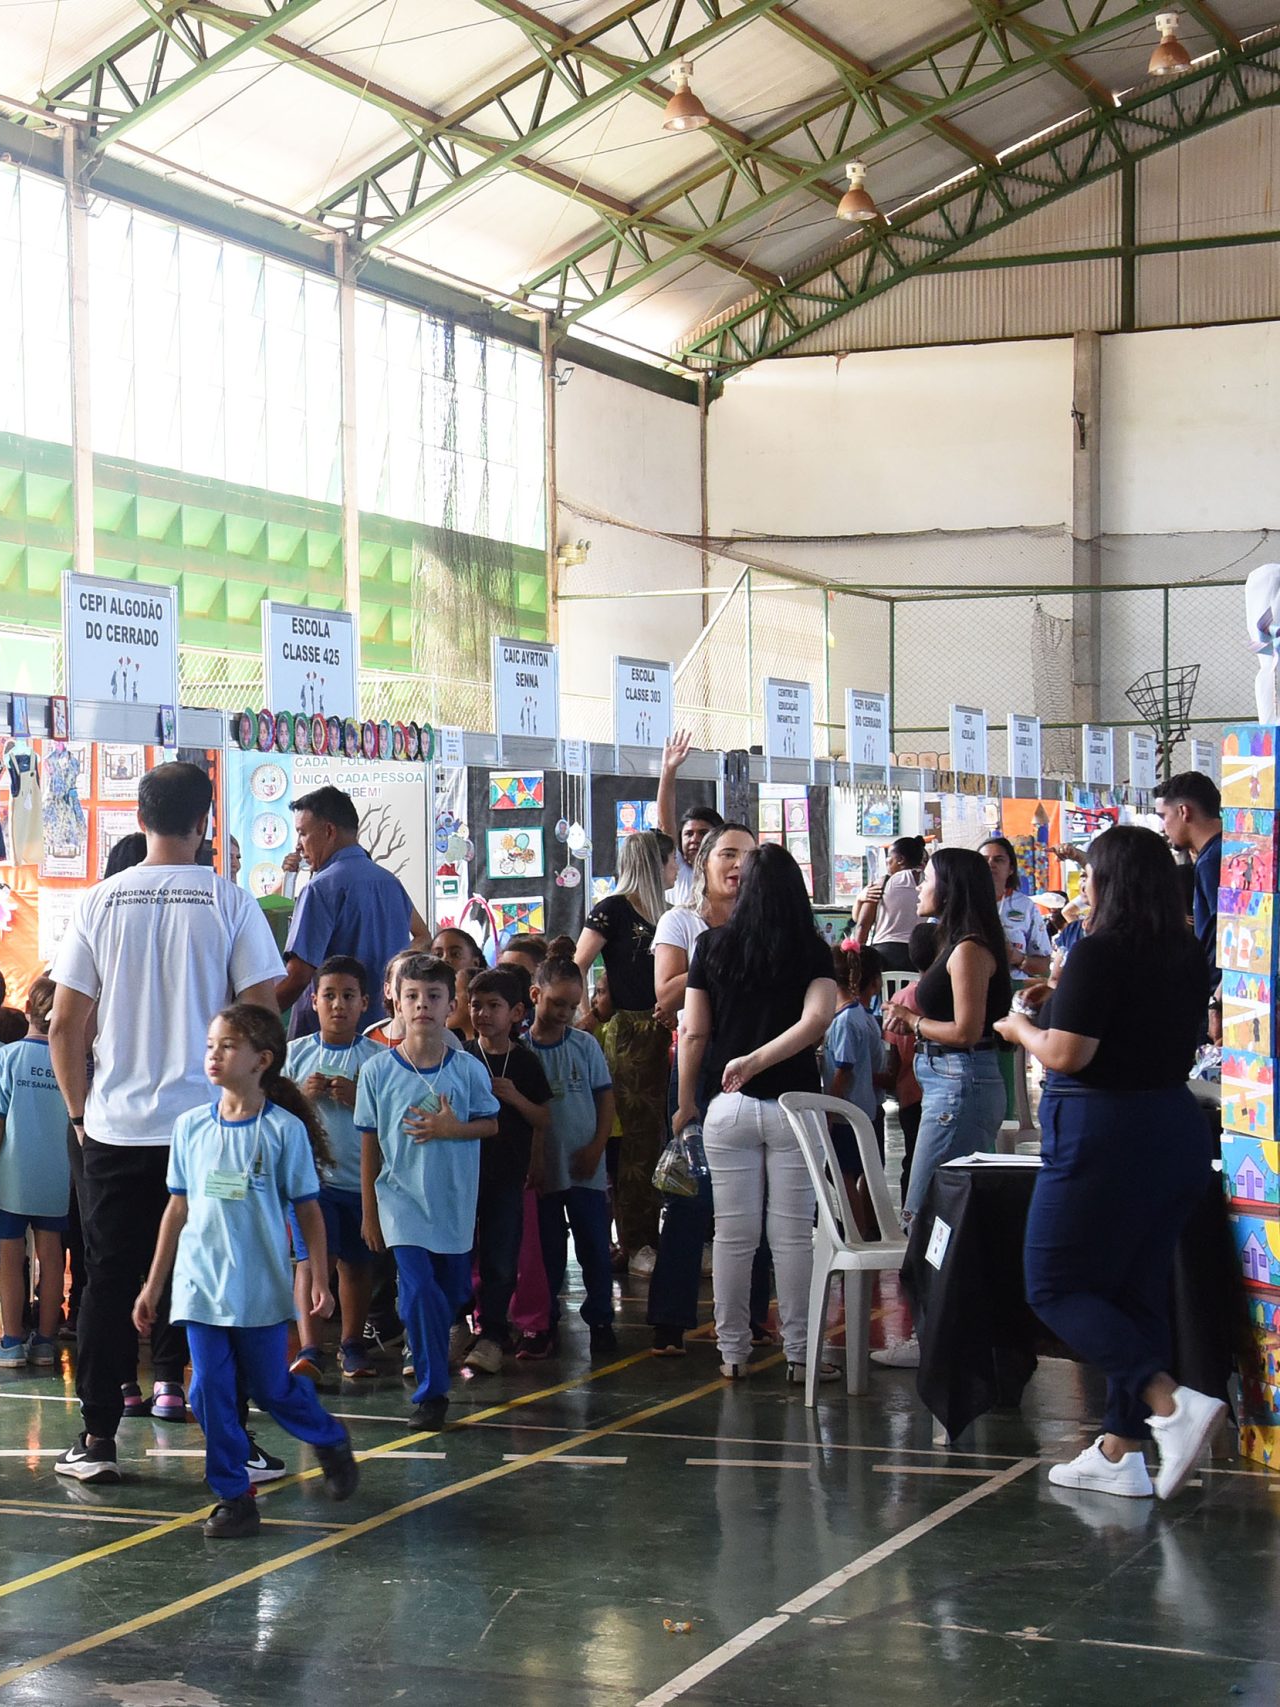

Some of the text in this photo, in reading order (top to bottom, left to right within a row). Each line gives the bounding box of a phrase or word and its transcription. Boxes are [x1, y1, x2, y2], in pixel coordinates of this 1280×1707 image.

[79, 592, 163, 621] CEPI ALGODÃO
[85, 621, 159, 648] DO CERRADO
[291, 616, 331, 639] ESCOLA
[282, 642, 340, 666] CLASSE 425
[503, 648, 549, 668] CAIC AYRTON
[515, 672, 539, 689] SENNA
[631, 668, 655, 683] ESCOLA
[625, 687, 650, 702] CLASSE
[295, 756, 329, 768] CADA
[294, 772, 331, 785] ÚNICA
[336, 773, 369, 784] CADA
[372, 772, 424, 783] PESSOA
[171, 888, 215, 899] REGIONAL
[116, 897, 149, 906] ENSINO
[150, 897, 161, 905] DE
[163, 898, 214, 906] SAMAMBAIA
[30, 1066, 44, 1077] EC
[16, 1080, 31, 1088] CRE
